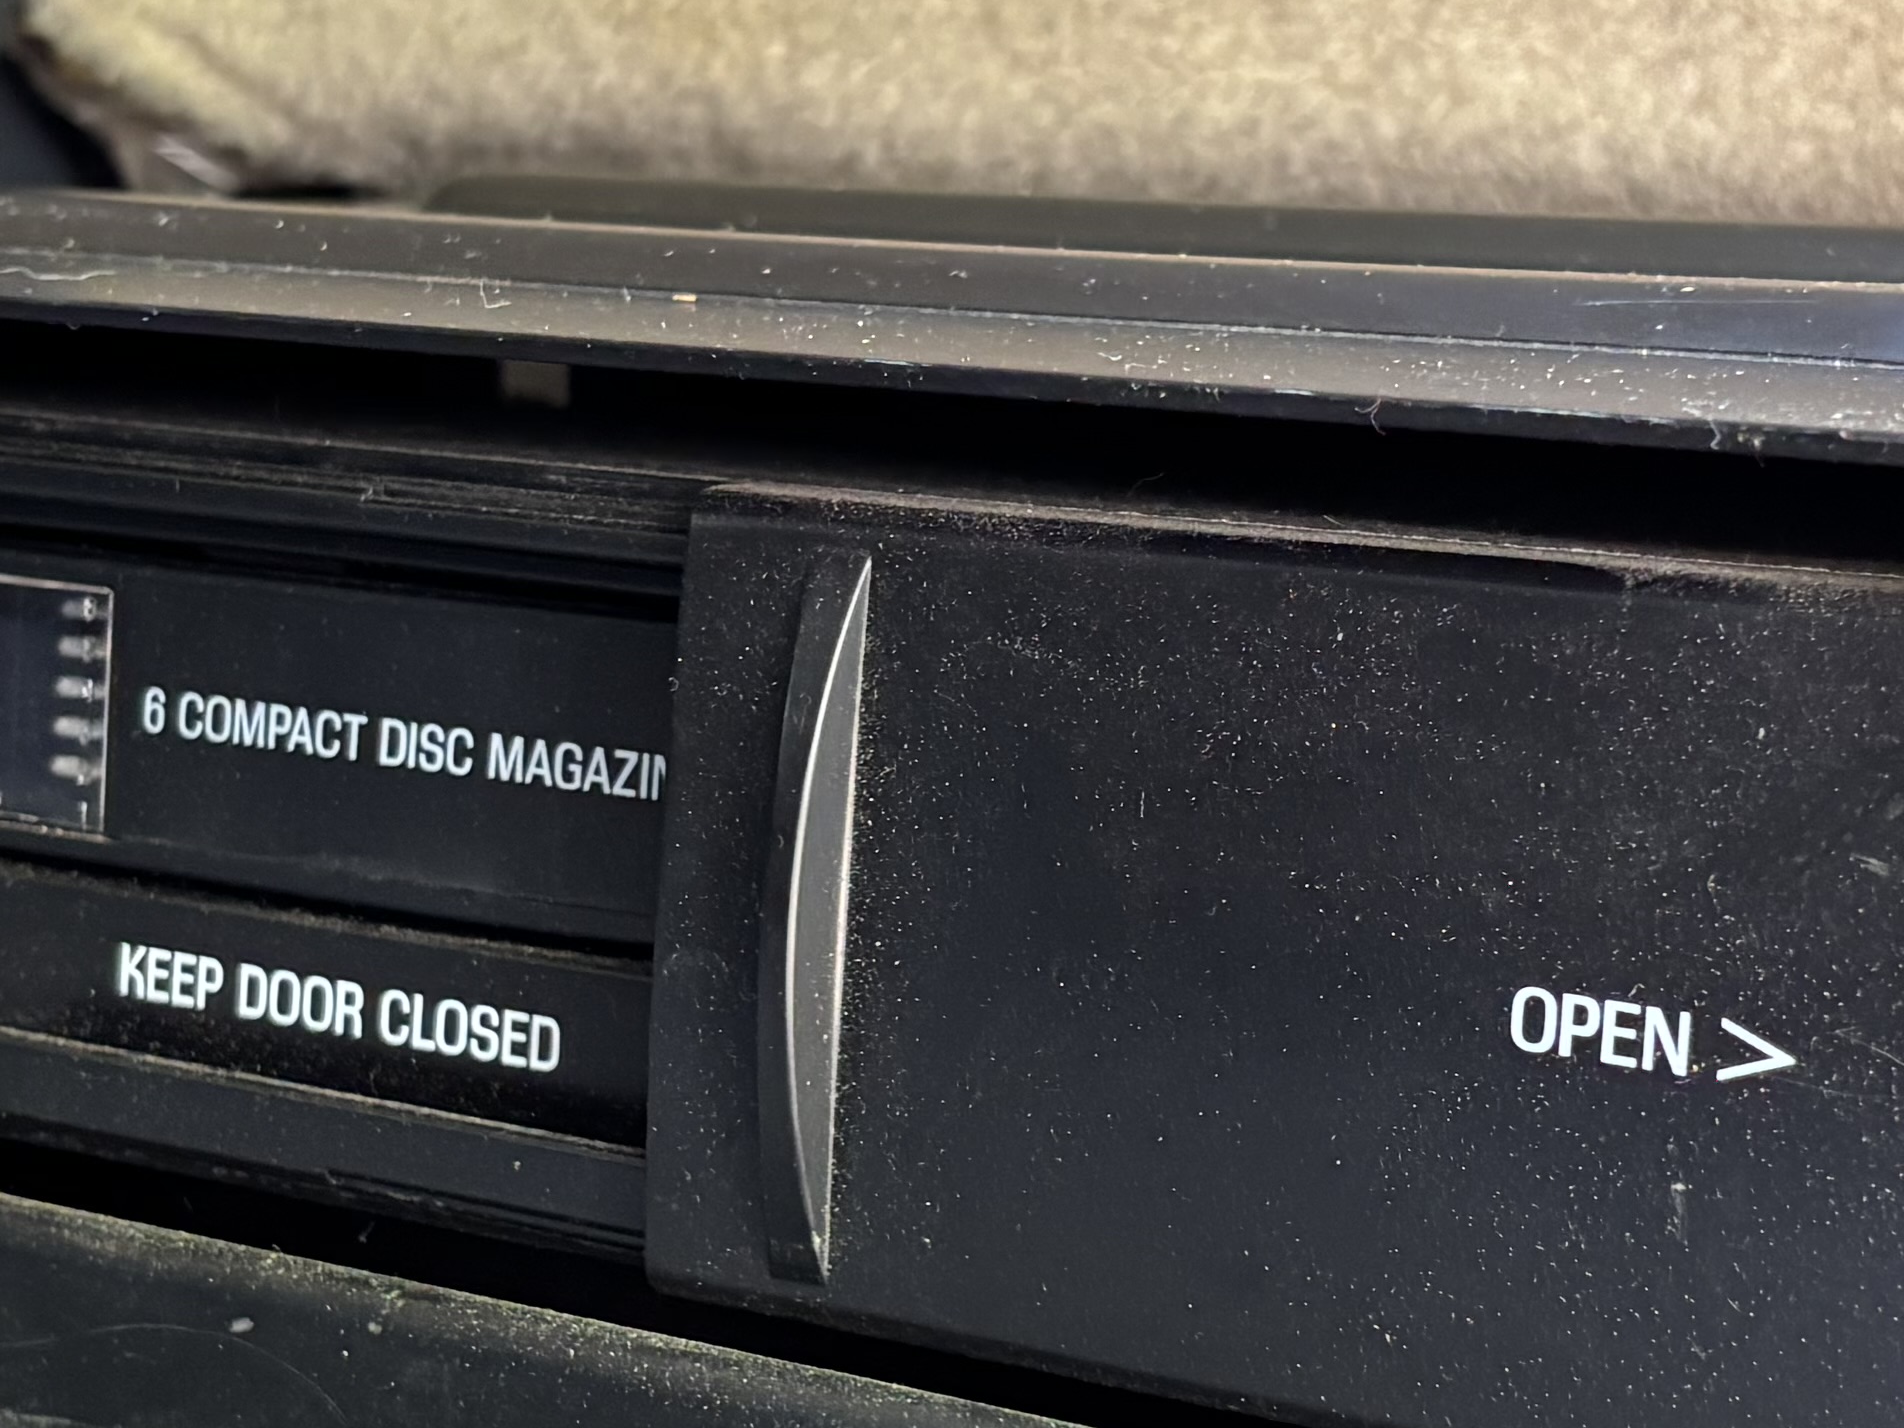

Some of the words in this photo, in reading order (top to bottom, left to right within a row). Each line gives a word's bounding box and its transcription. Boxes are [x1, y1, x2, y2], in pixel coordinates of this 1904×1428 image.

[143, 685, 166, 734] 6
[177, 691, 369, 761] COMPACT
[378, 717, 475, 776] DISC
[117, 941, 224, 1011] KEEP
[236, 963, 364, 1040] DOOR
[379, 989, 562, 1072] CLOSED
[1510, 986, 1691, 1077] OPEN
